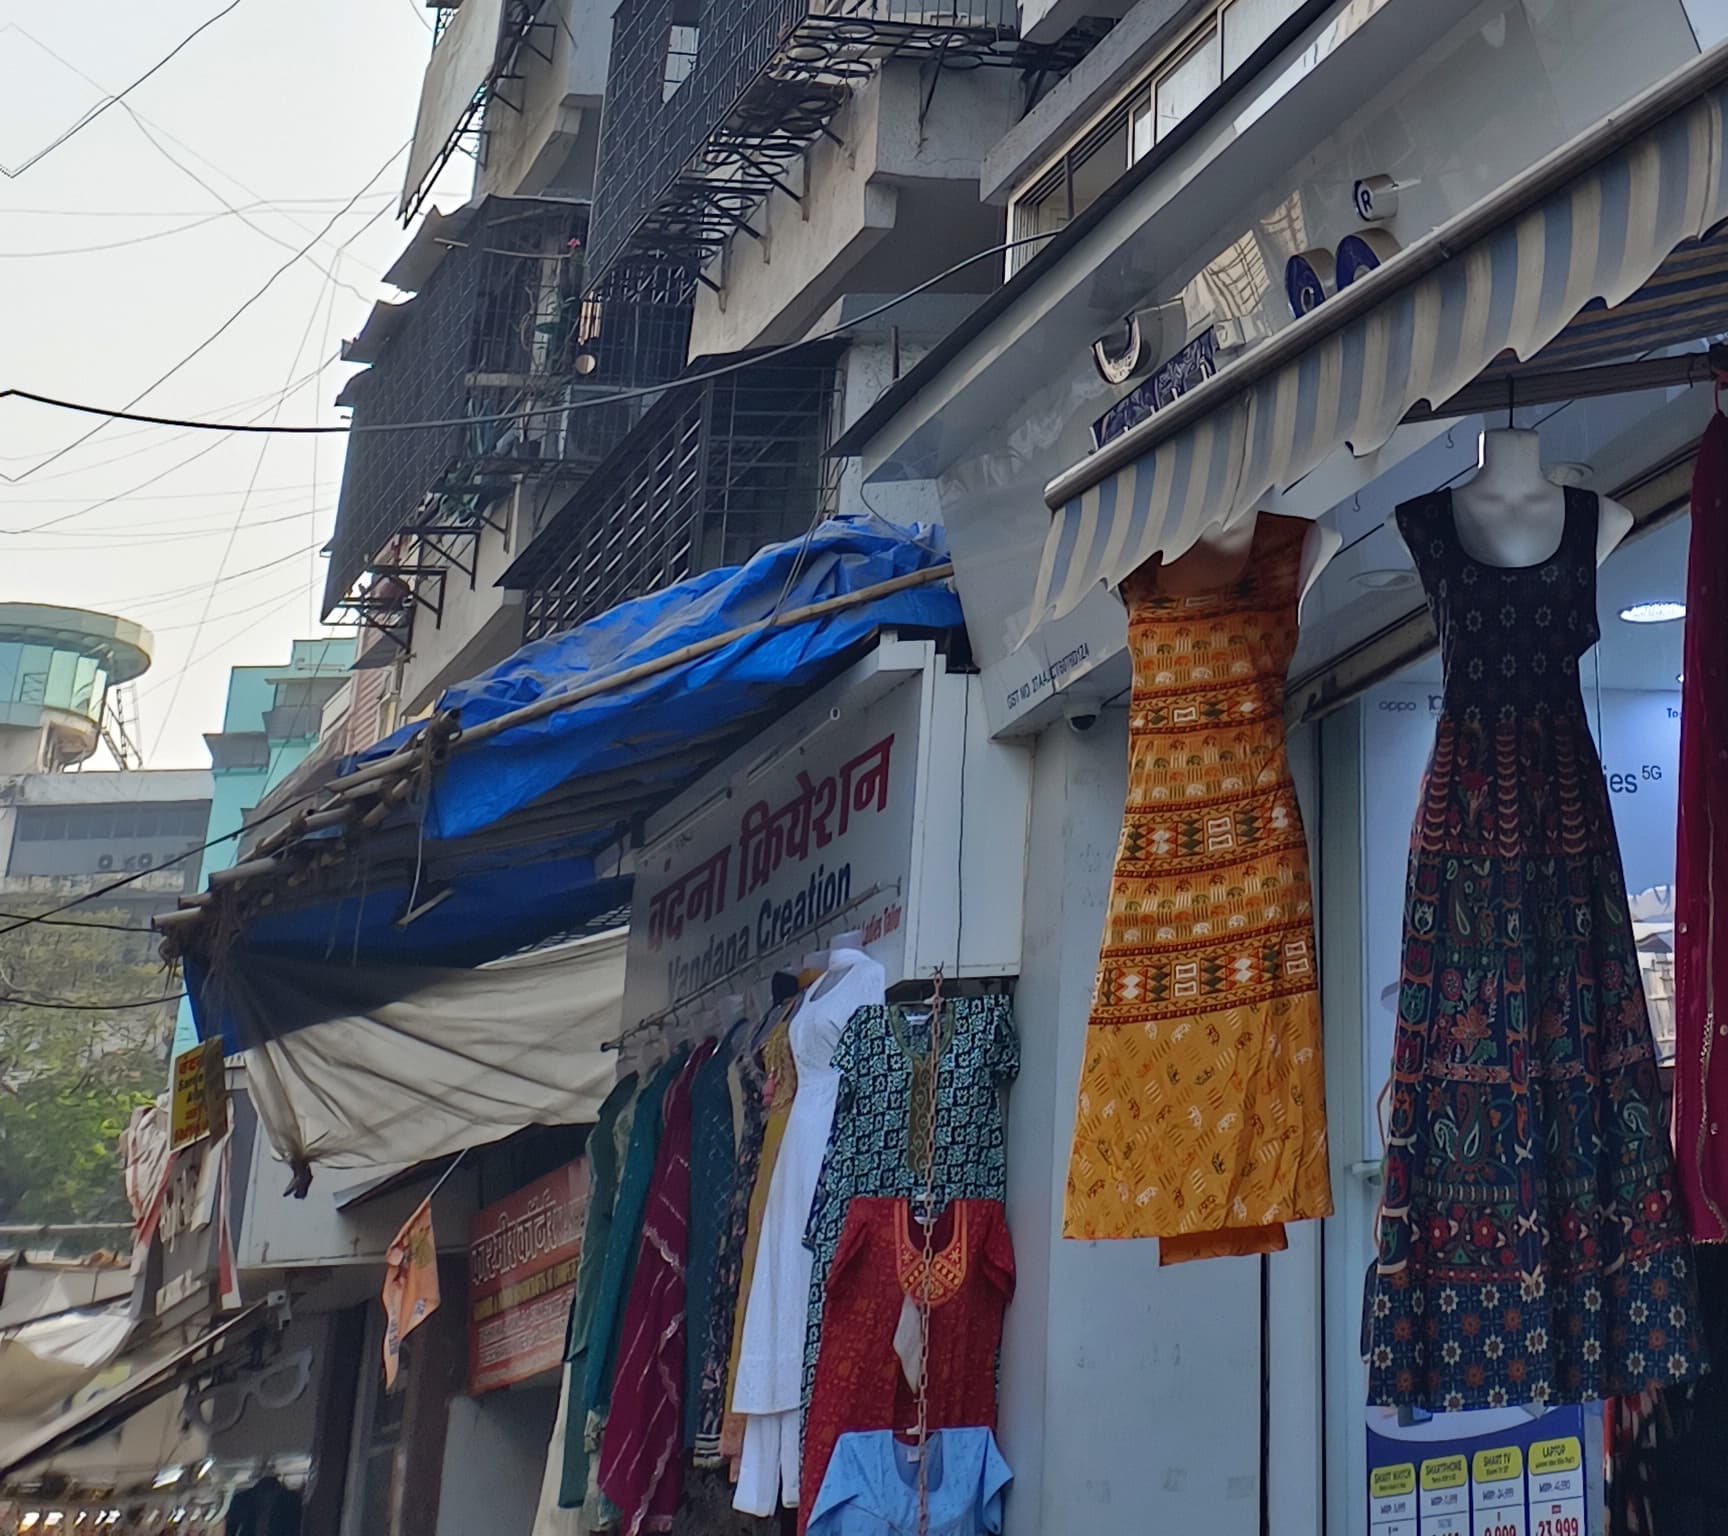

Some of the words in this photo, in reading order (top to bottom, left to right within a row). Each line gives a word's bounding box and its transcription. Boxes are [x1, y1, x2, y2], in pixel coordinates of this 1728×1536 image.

[1641, 765, 1662, 781] 5G
[668, 925, 749, 995] Vandana
[756, 862, 851, 953] Creation
